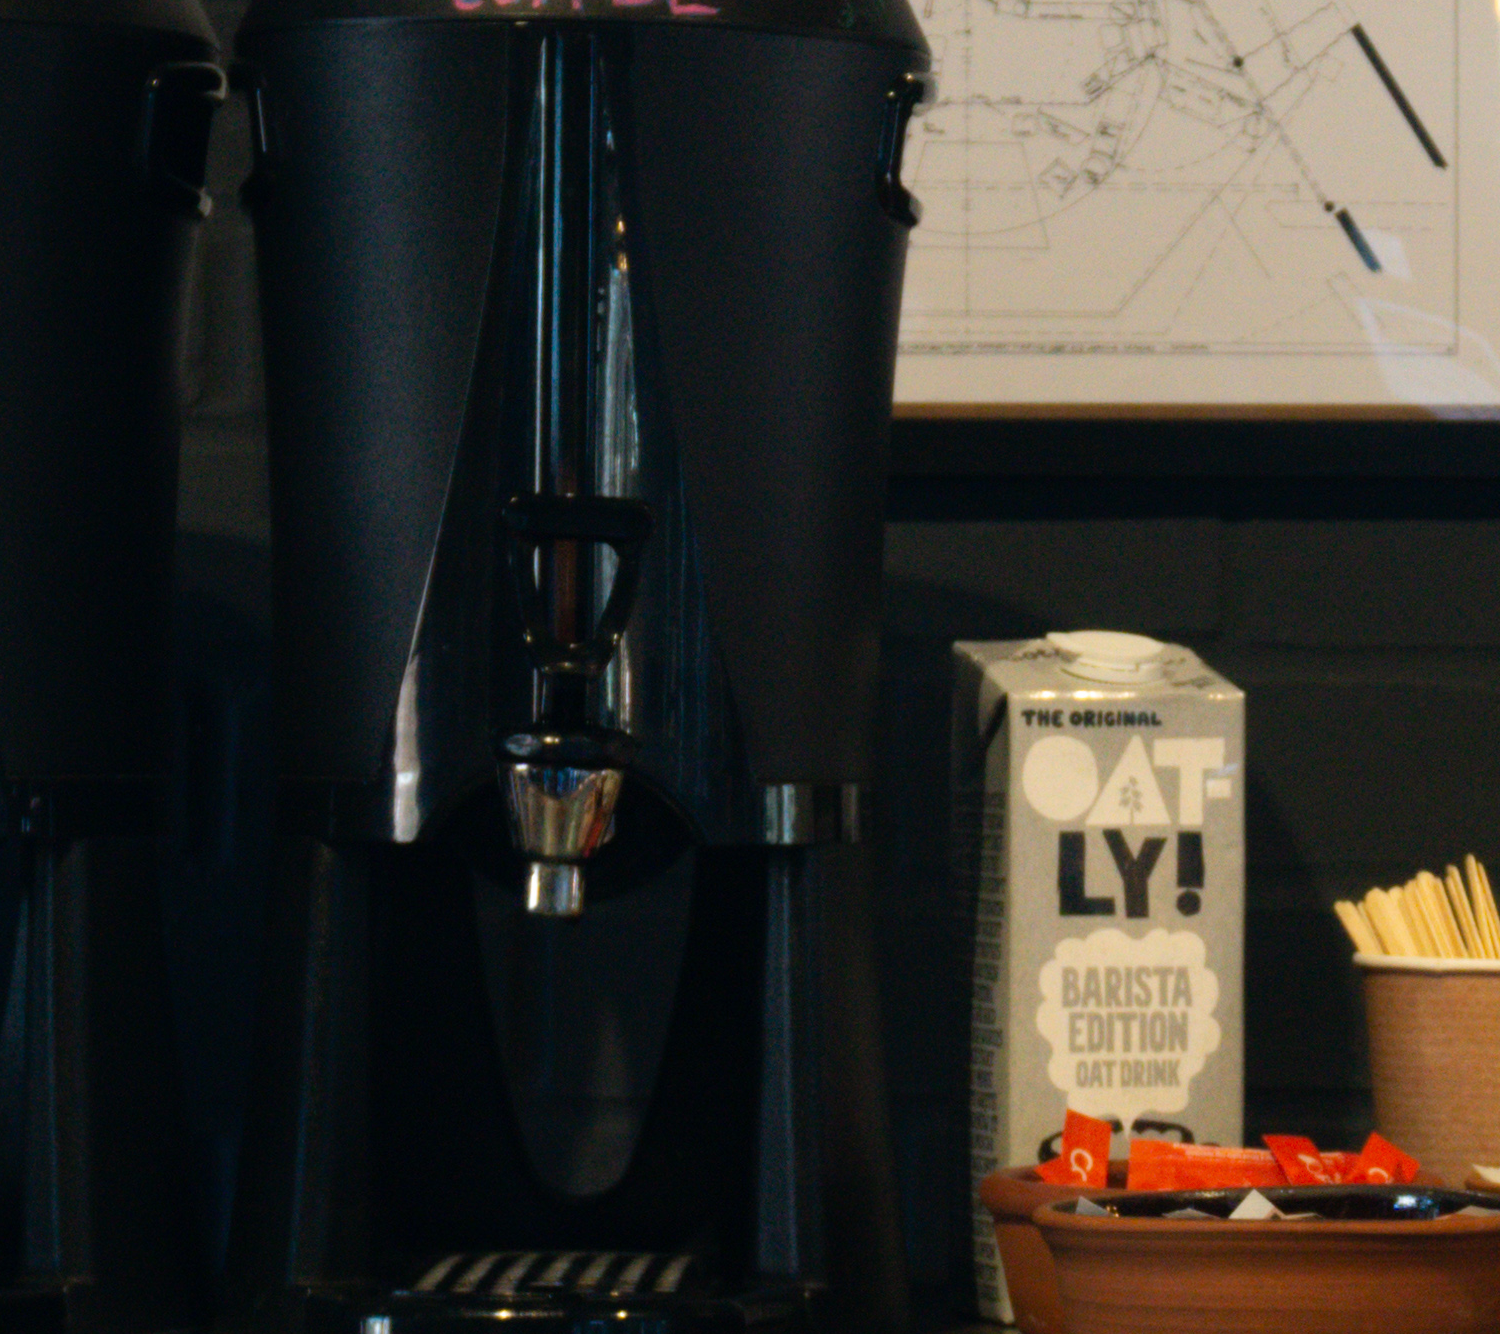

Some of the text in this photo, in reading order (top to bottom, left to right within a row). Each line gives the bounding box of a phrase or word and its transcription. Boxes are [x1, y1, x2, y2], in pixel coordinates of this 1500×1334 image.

[1021, 709, 1162, 728] THE ORIGINAL
[1057, 827, 1206, 919] LY!
[1061, 965, 1193, 1008] BARISTA
[1068, 1011, 1189, 1054] EDITION
[1075, 1058, 1181, 1088] OAT DRINK
